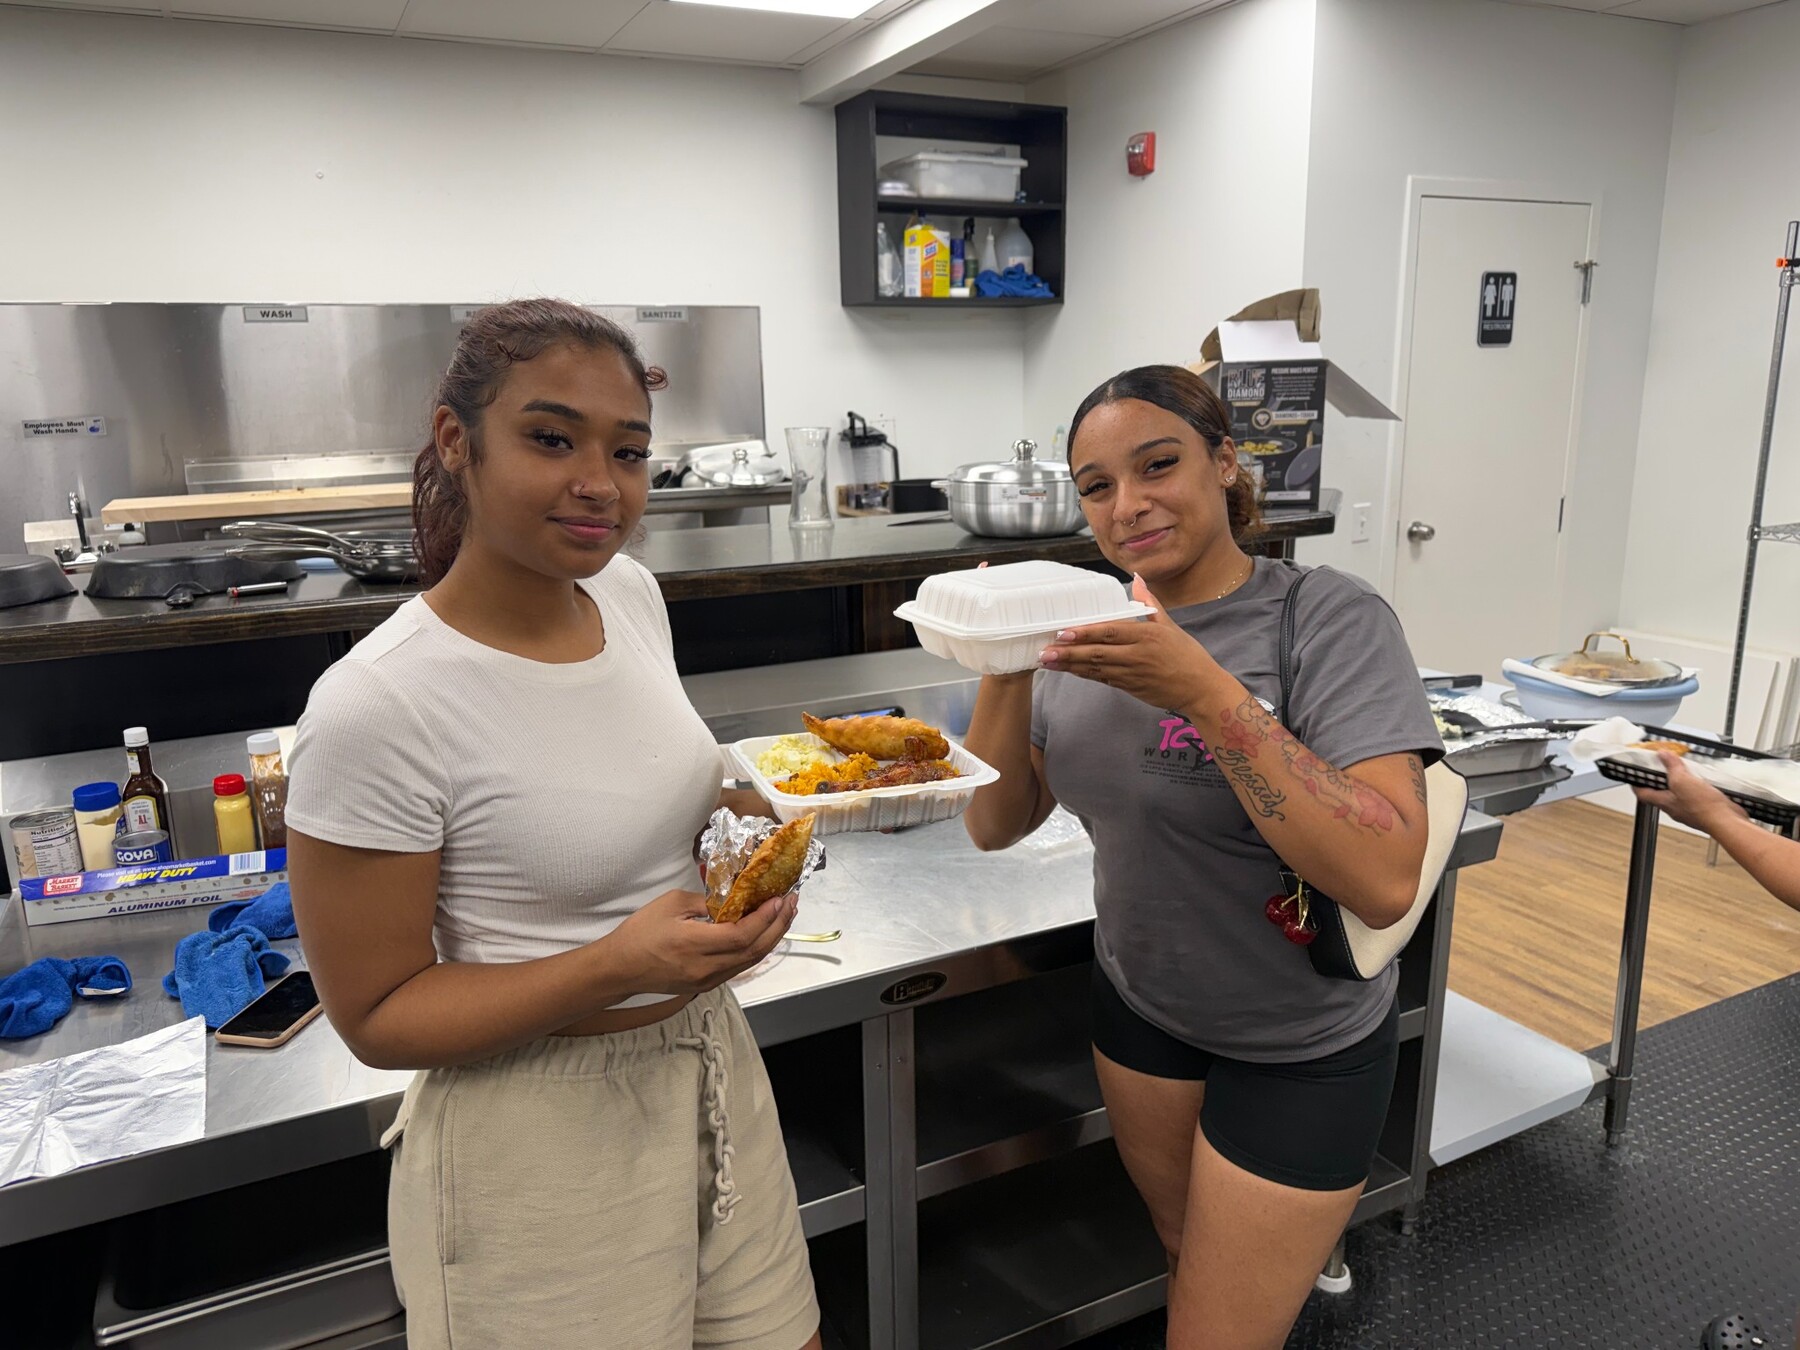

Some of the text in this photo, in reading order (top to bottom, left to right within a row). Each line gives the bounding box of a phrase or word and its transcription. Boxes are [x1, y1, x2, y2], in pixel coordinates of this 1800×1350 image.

[260, 310, 292, 318] WASH
[642, 311, 682, 319] SANITIZE
[1227, 388, 1265, 398] DIAMOND
[24, 421, 63, 429] Employees
[30, 826, 65, 835] Nutrition
[116, 848, 153, 862] GOYA
[116, 866, 198, 884] HEAVY DUTY
[108, 898, 188, 914] ALUMINUM
[192, 894, 222, 904] FOIL
